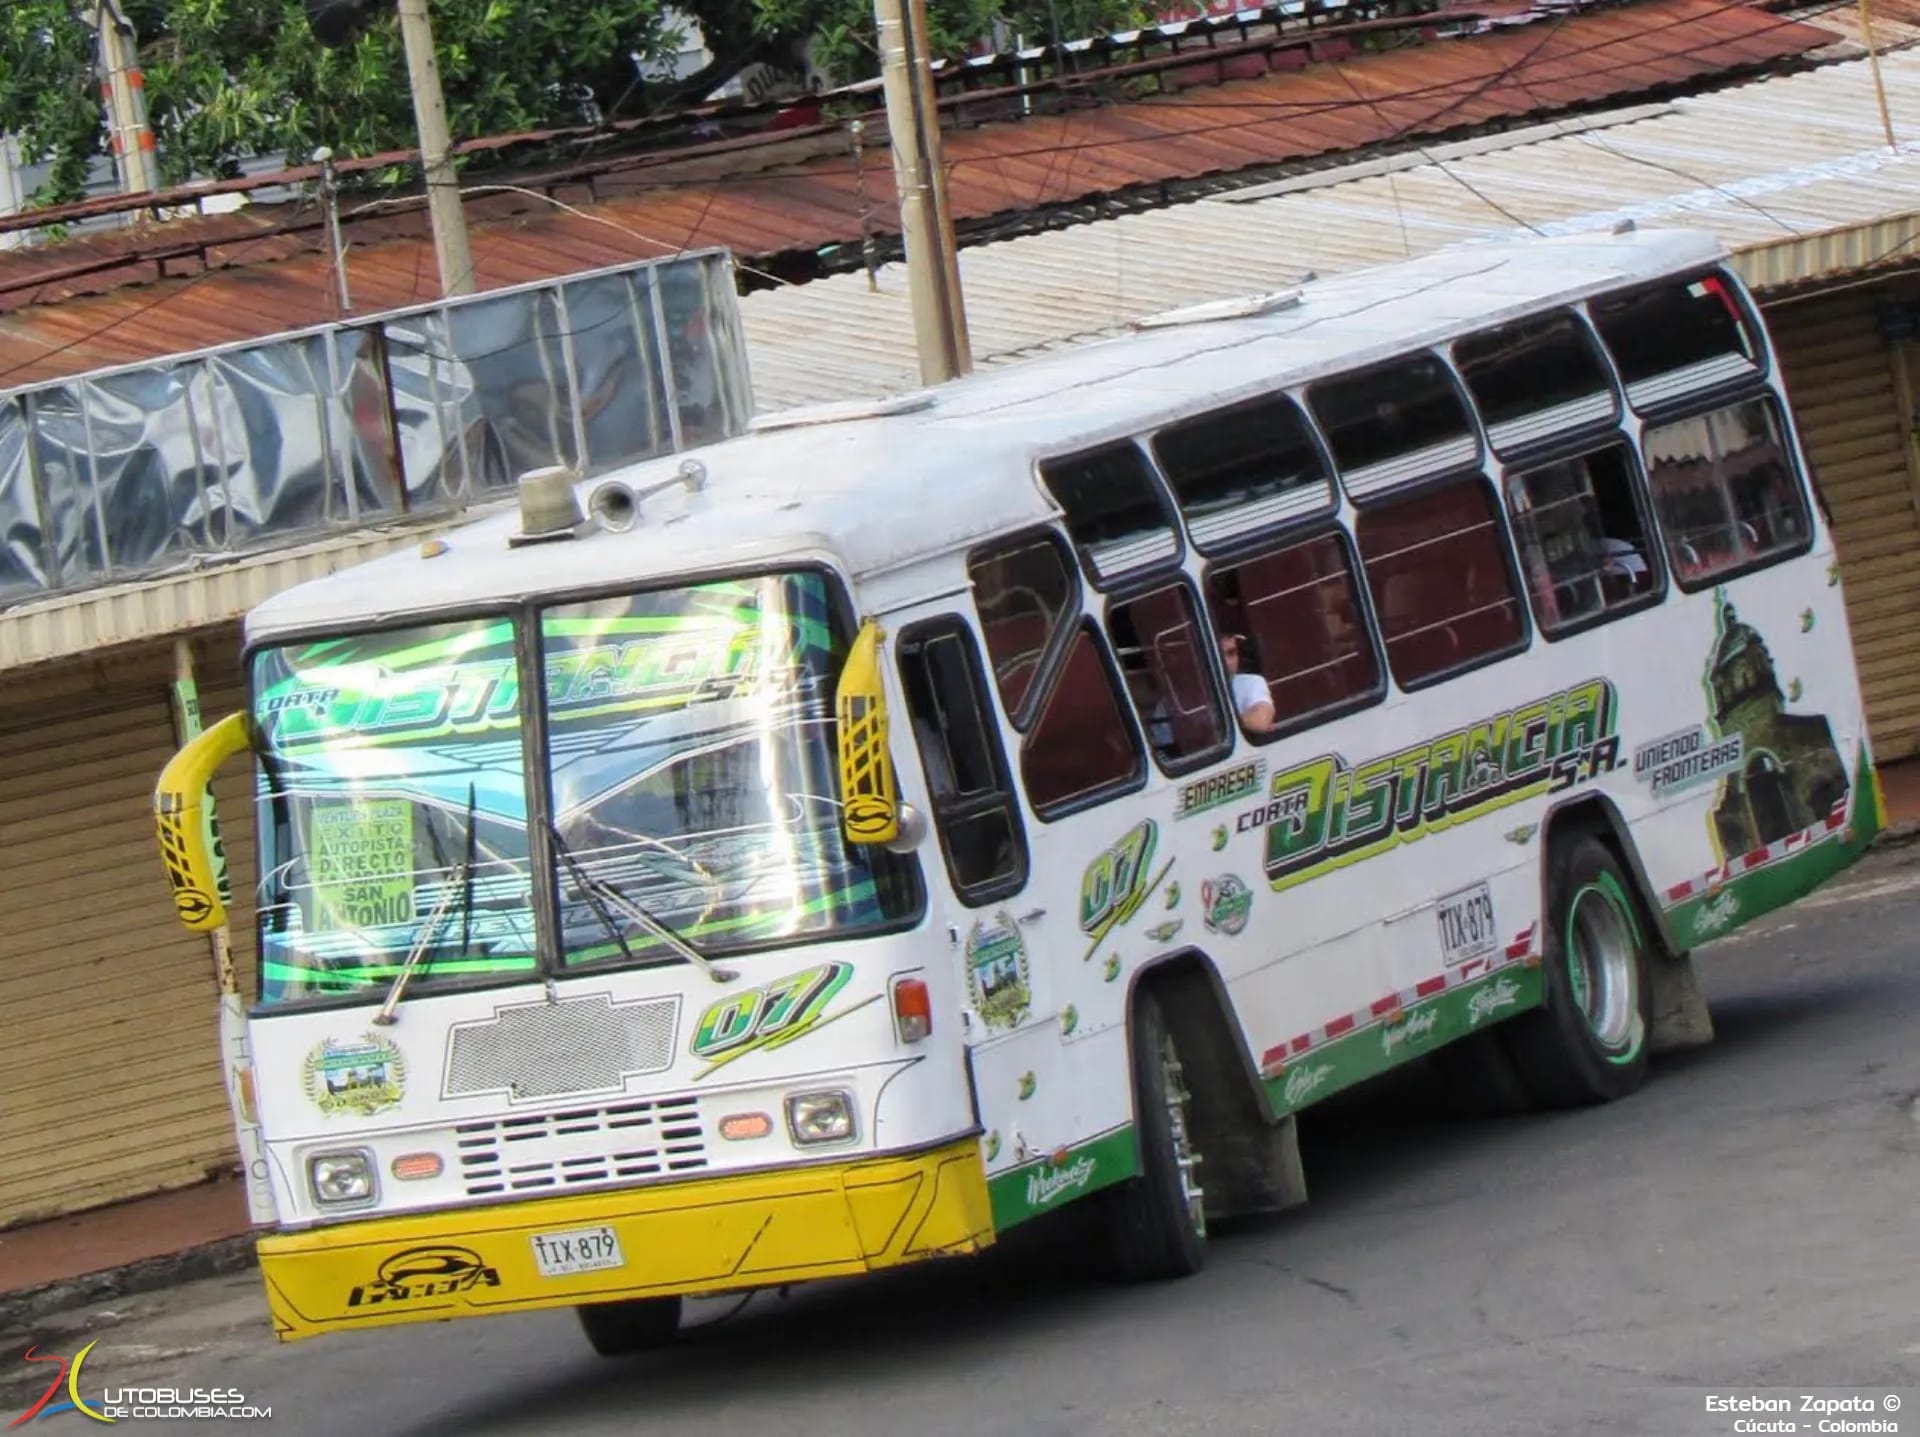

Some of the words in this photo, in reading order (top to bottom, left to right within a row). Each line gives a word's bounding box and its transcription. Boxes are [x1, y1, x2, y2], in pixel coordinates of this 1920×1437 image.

[1635, 731, 1700, 773] UNIENDO
[1650, 739, 1741, 790] FRONTERAS
[1184, 763, 1258, 811] EMPRESA
[320, 838, 405, 857] AUTOPISTA
[344, 885, 383, 903] SAN
[689, 961, 855, 1062] 07
